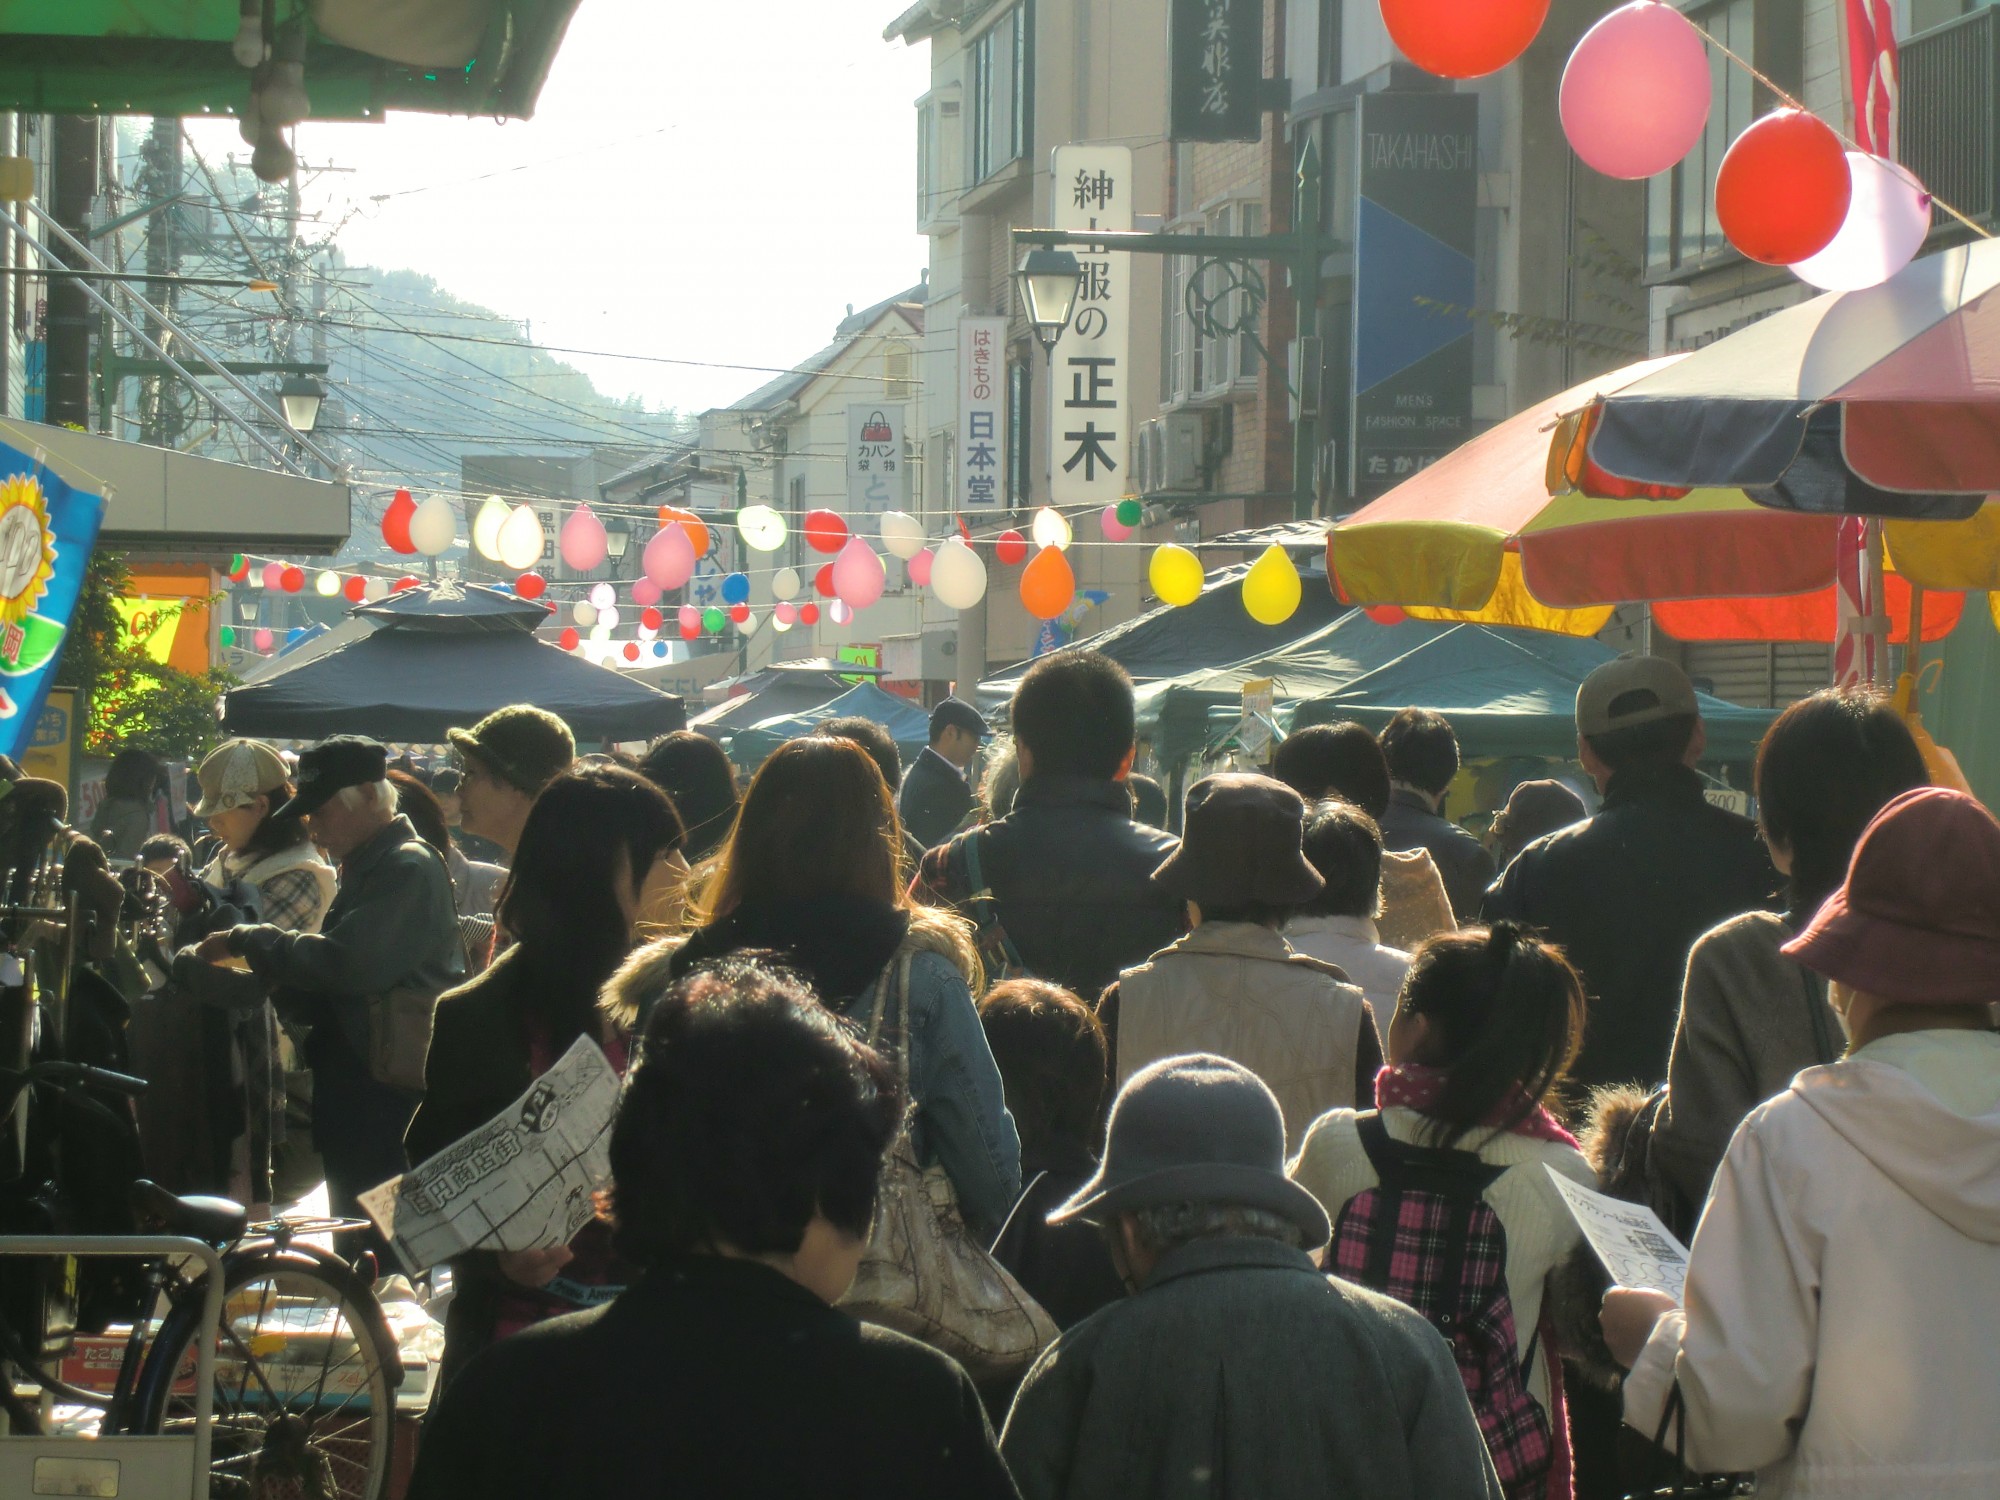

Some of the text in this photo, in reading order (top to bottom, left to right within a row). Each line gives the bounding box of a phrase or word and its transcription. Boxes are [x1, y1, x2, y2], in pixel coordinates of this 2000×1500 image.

[1367, 133, 1472, 170] TAKAHASHI
[973, 329, 991, 400] はきもの
[858, 444, 896, 458] カバン
[1062, 357, 1118, 482] 正木
[1365, 415, 1462, 430] FASHION SPACE
[966, 411, 996, 504] 日本堂
[402, 1129, 521, 1216] 百円商店街
